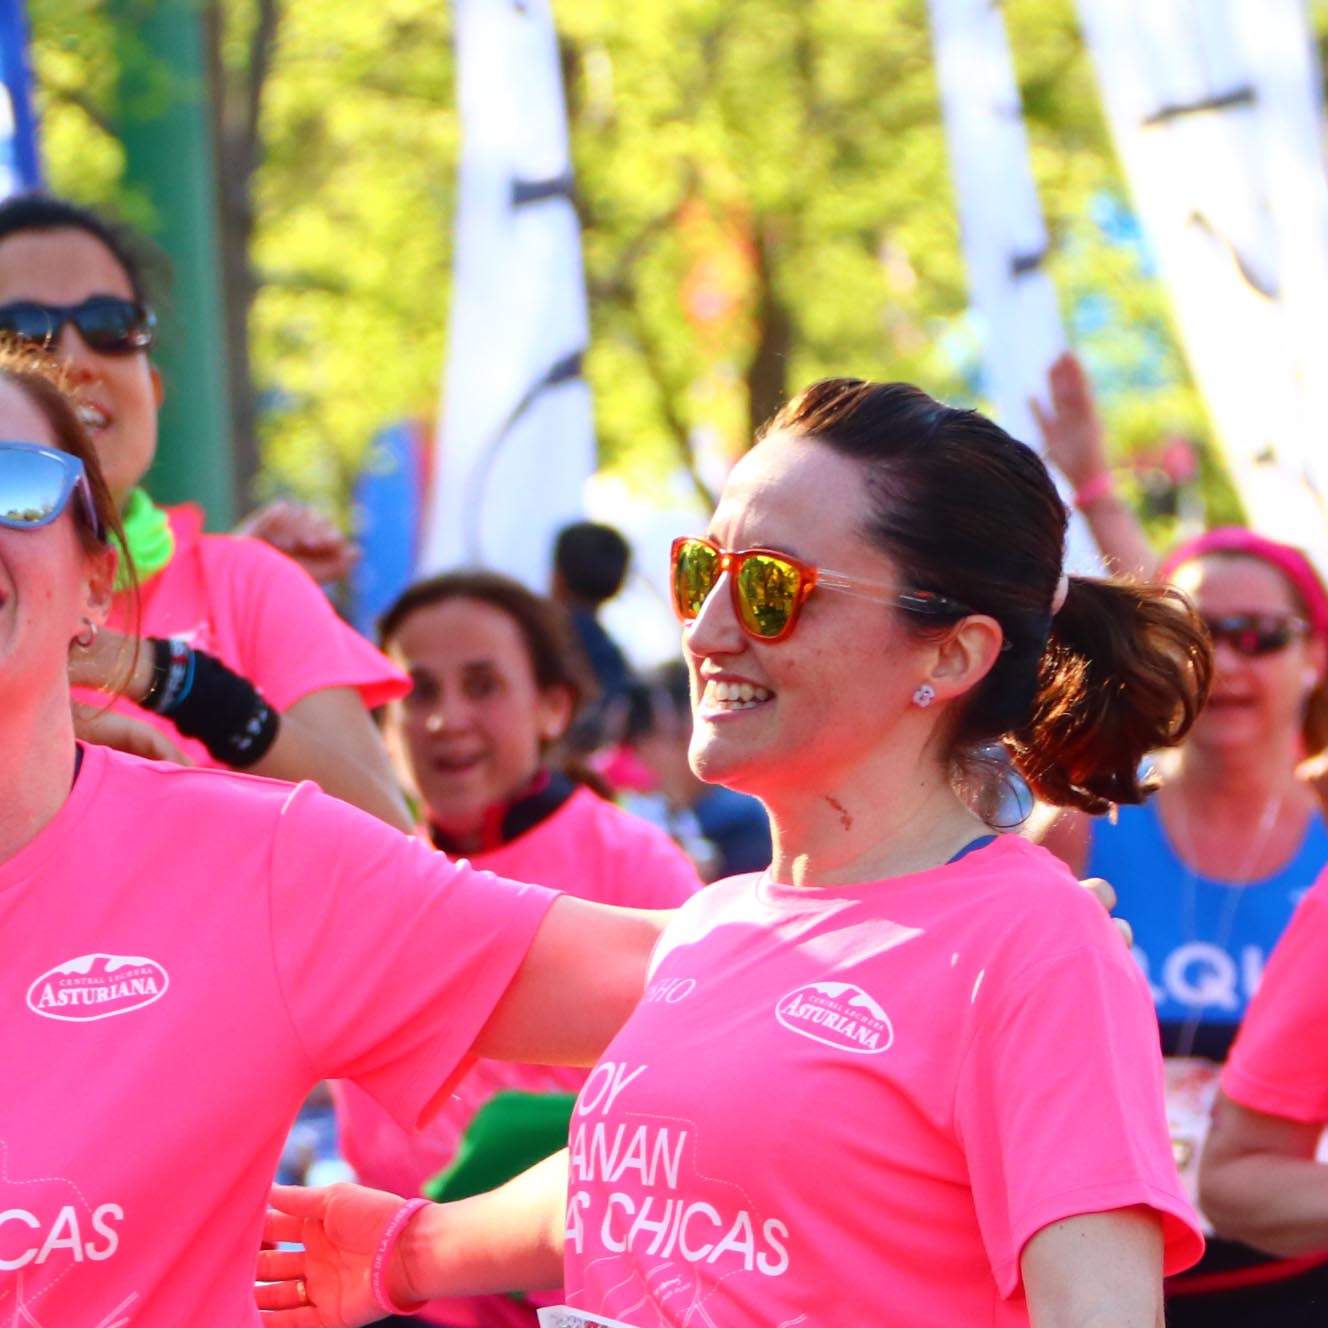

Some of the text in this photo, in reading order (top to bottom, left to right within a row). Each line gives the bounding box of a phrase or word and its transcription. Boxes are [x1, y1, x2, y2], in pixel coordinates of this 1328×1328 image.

[36, 976, 160, 1009] ASTURIANA
[779, 993, 881, 1049] ASTURIANA
[600, 1191, 790, 1277] CHICAS
